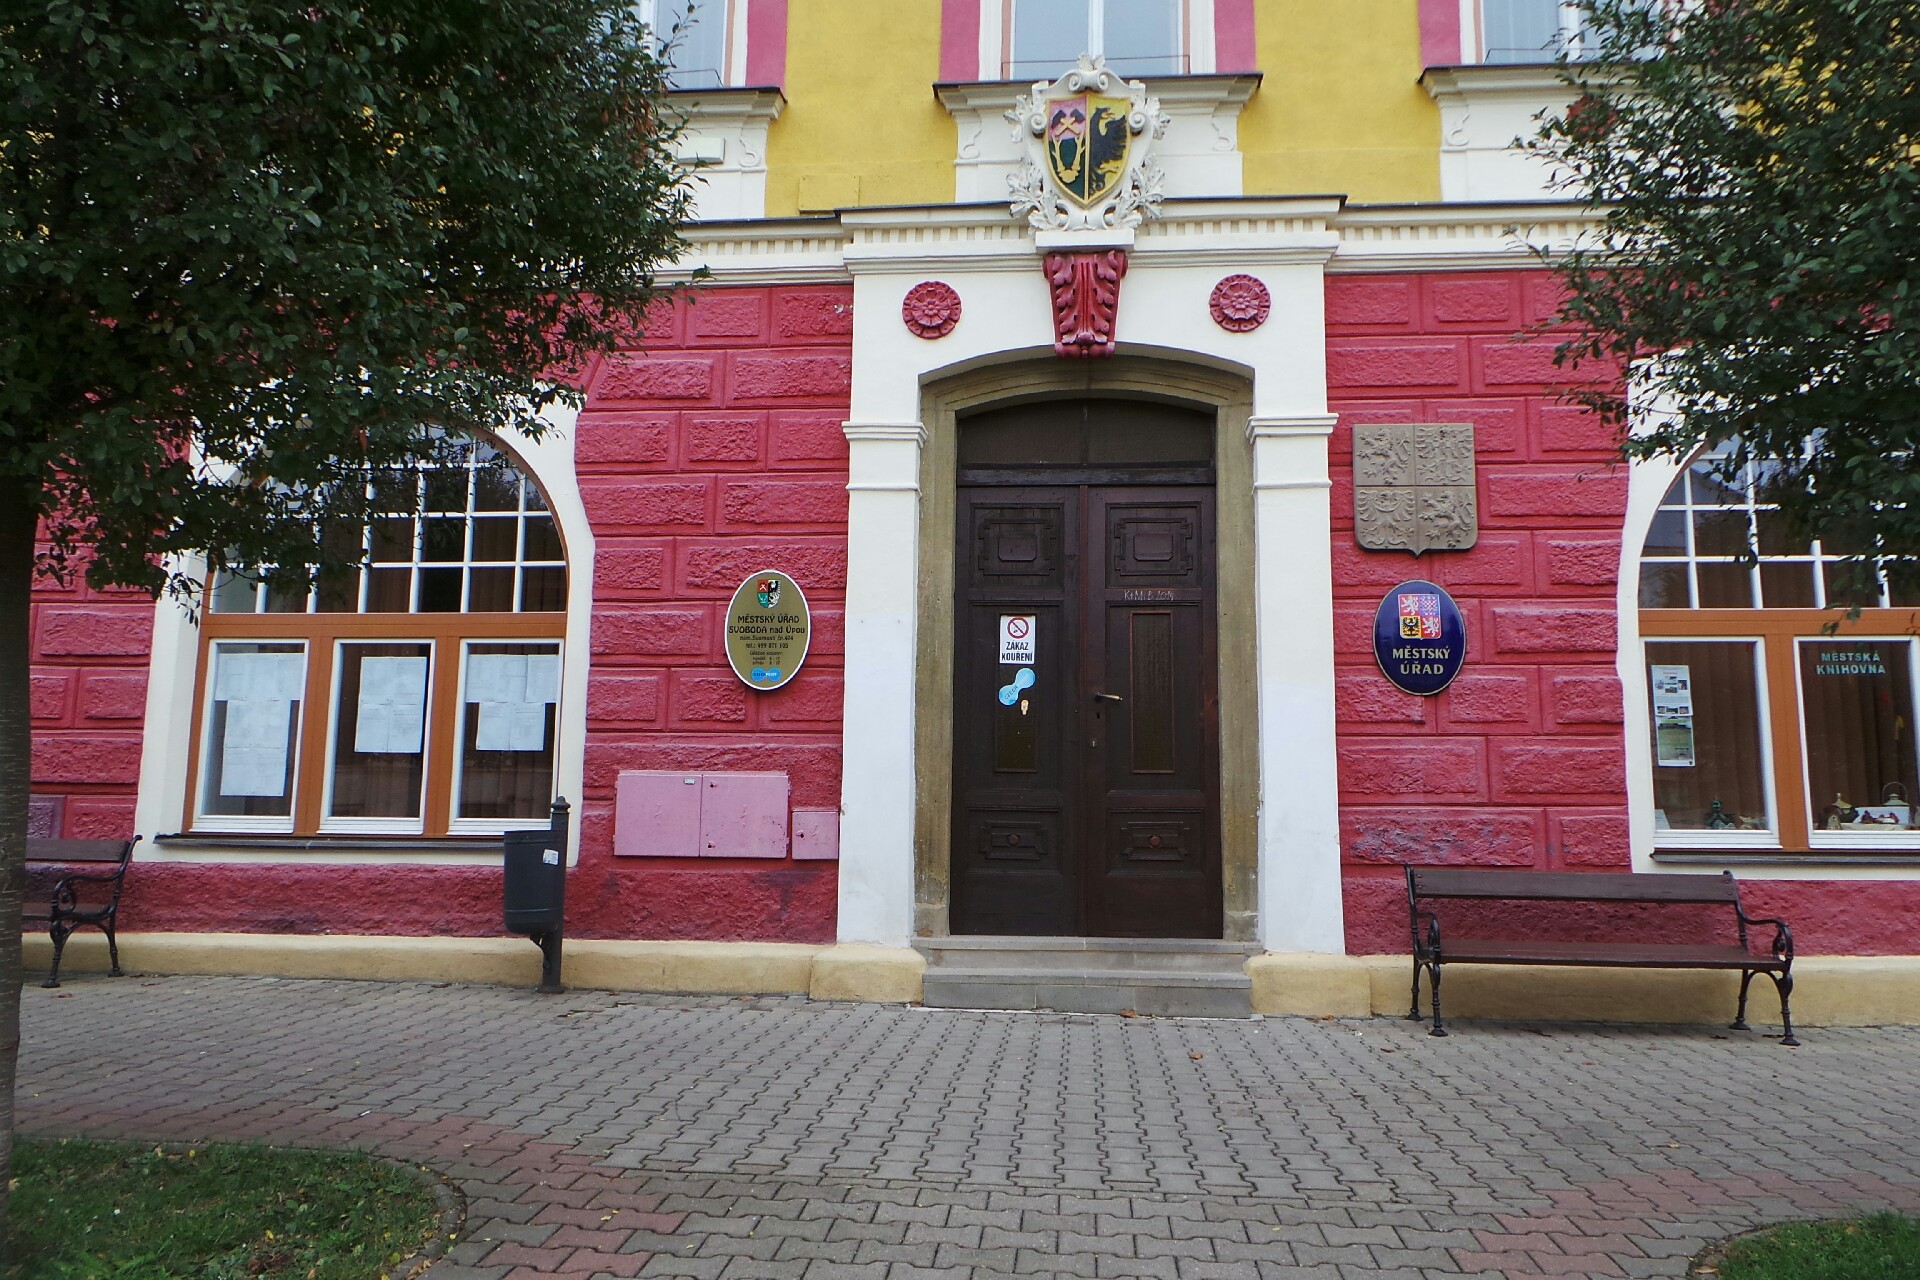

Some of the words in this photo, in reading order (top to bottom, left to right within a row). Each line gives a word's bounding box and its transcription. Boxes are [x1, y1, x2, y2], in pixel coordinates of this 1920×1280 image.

[738, 613, 775, 623] MĚSTSKÝ
[777, 613, 799, 623] ÚŘAD
[728, 625, 767, 634] SVOBODA
[769, 626, 783, 634] nad
[785, 625, 805, 634] Úpou
[1006, 640, 1029, 650] ZÁKAZ
[1392, 645, 1451, 659] MĚSTSKÝ
[1821, 650, 1881, 661] MĚSTSKÁ
[1400, 661, 1444, 675] ÚŘAD
[1816, 664, 1886, 675] KNIHOVNA
